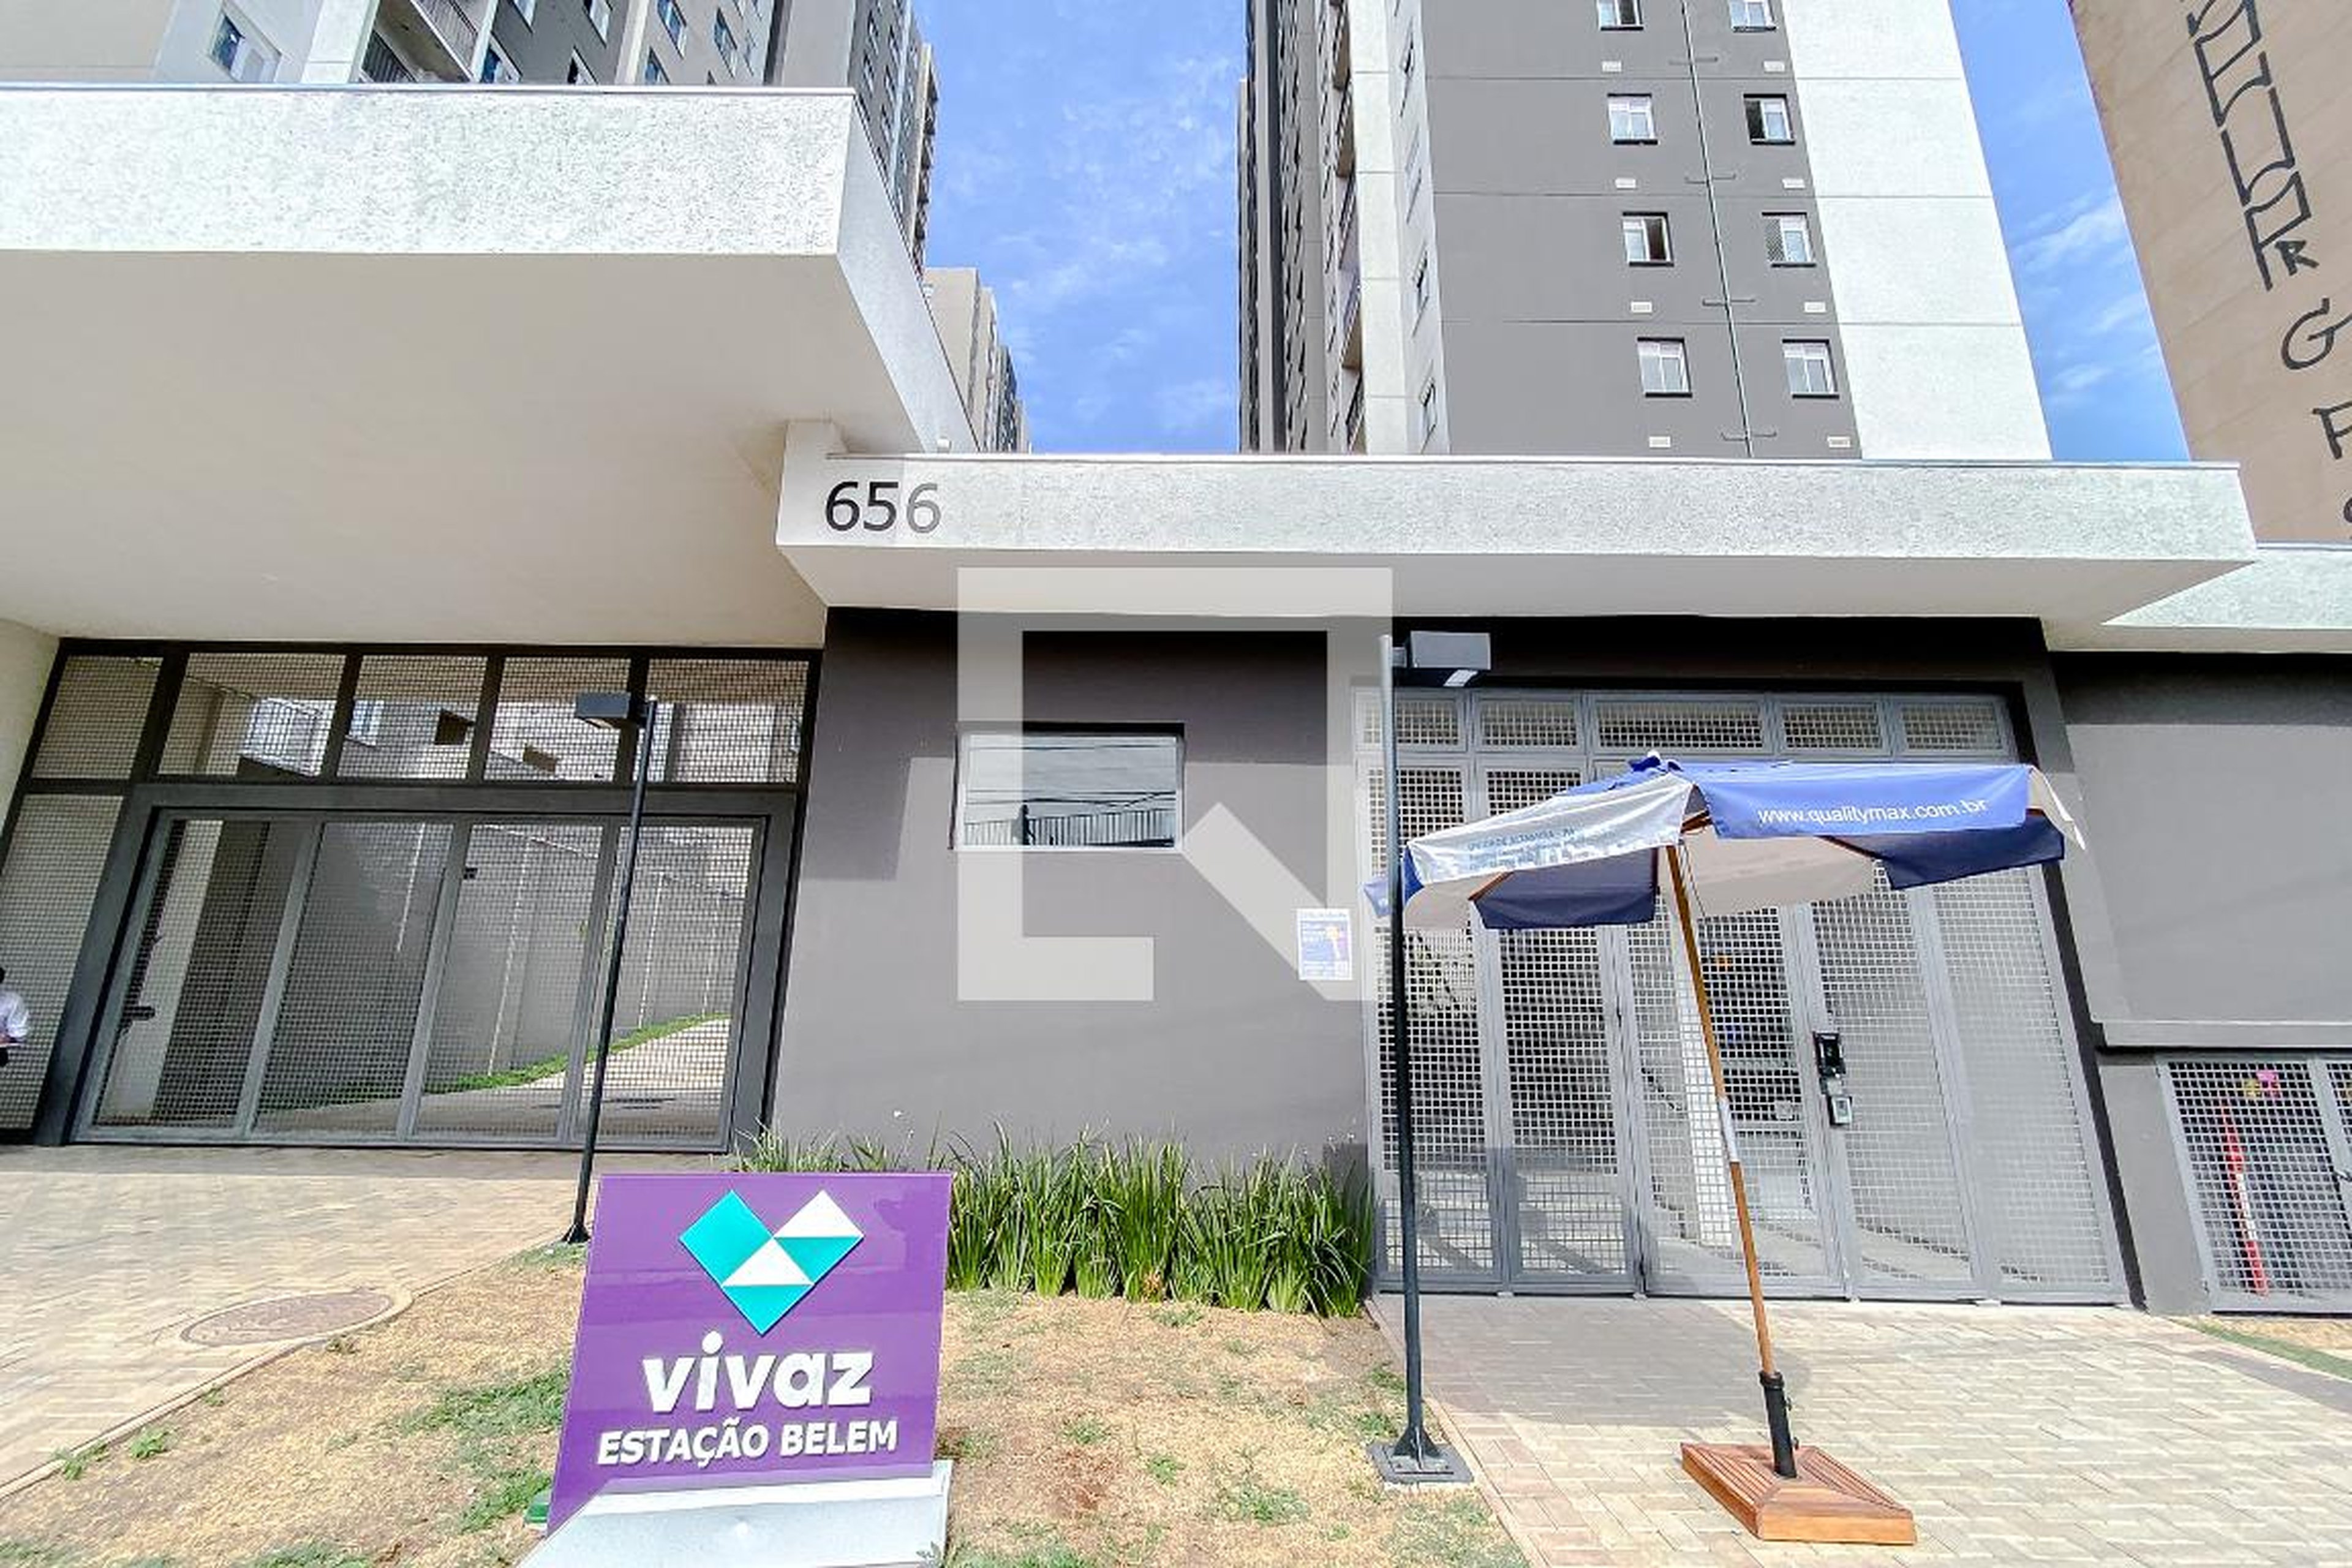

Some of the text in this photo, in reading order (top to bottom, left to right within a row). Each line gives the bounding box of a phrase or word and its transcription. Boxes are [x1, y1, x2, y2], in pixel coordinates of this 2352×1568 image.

[824, 481, 942, 534] 656
[1757, 799, 1988, 826] www.qualitymax.com.br
[642, 1330, 873, 1414] vivaz
[597, 1417, 899, 1468] ESTAÇÃO BELEM
